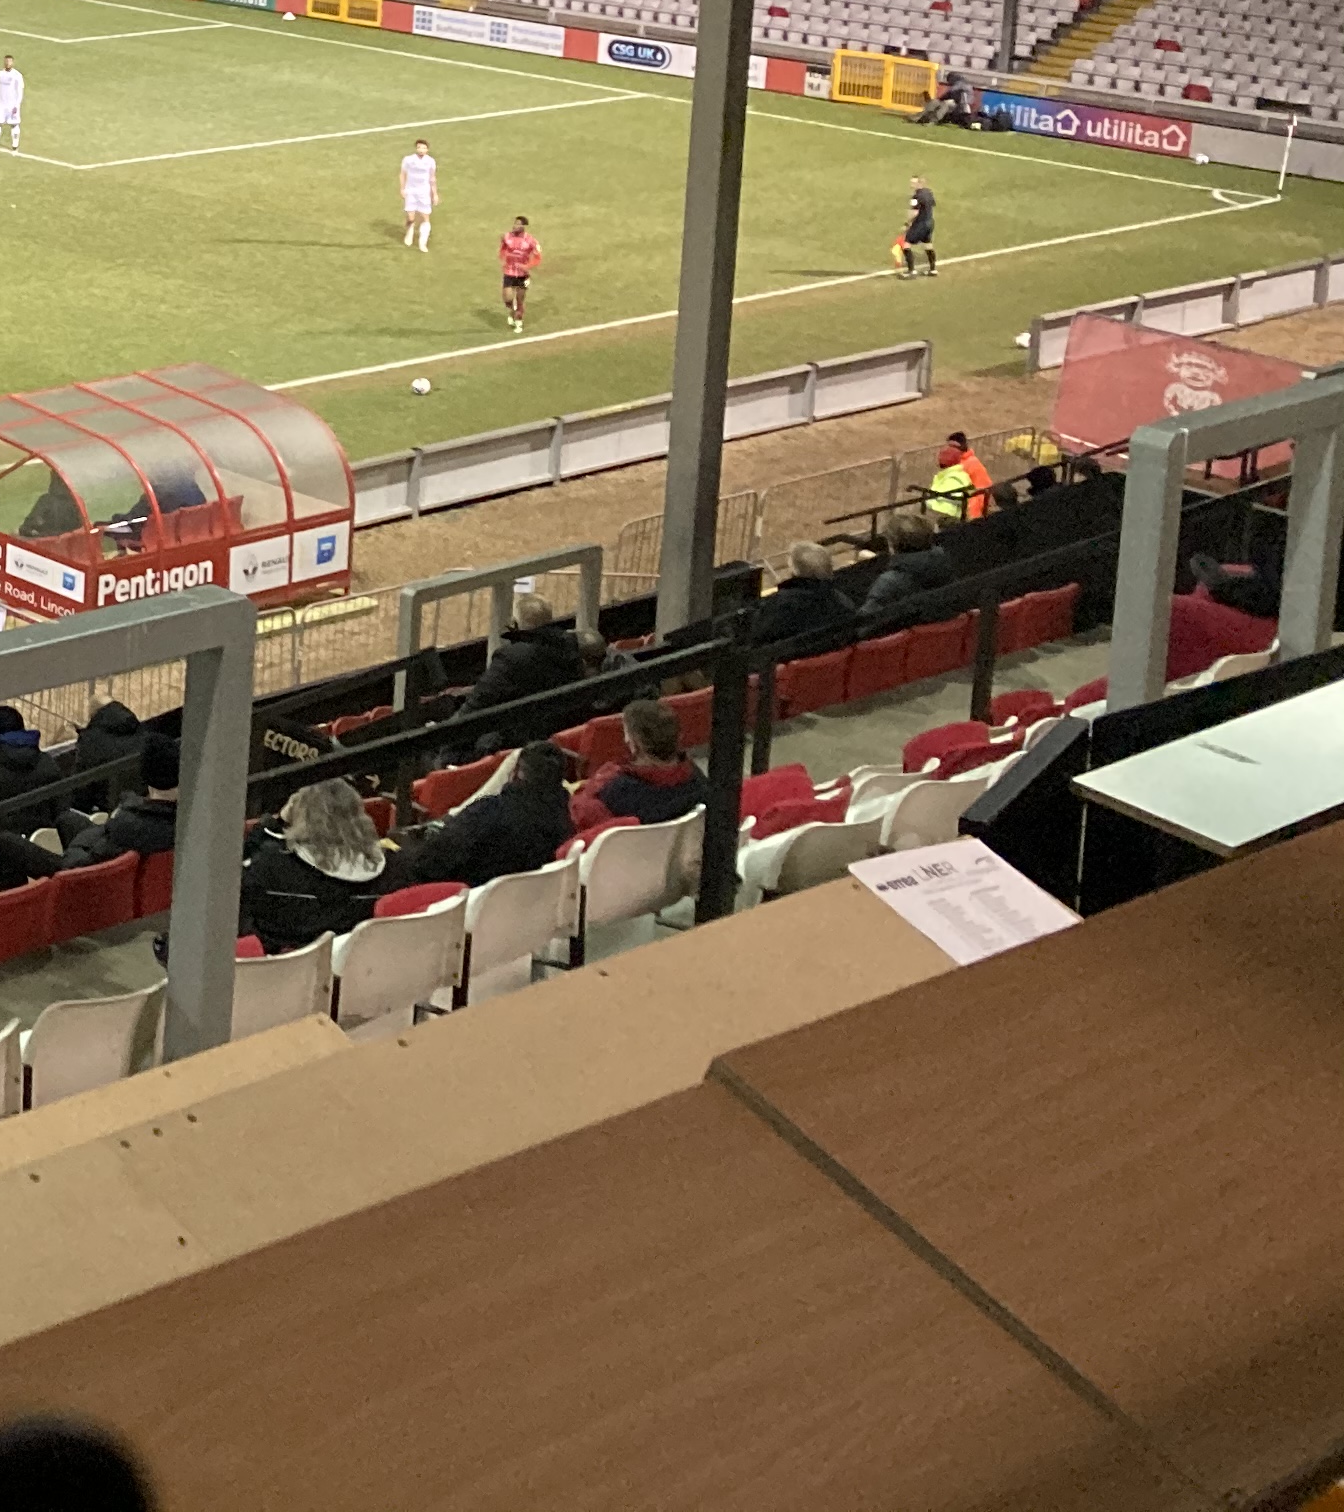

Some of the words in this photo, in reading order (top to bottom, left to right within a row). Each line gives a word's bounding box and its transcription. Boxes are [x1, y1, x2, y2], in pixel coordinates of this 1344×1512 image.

[611, 42, 635, 56] CSG
[637, 45, 655, 59] UK
[1086, 116, 1160, 148] utilita
[4, 581, 38, 608] Road,
[40, 595, 76, 617] Lincol
[263, 728, 320, 763] ECTORS
[912, 860, 960, 883] LNER
